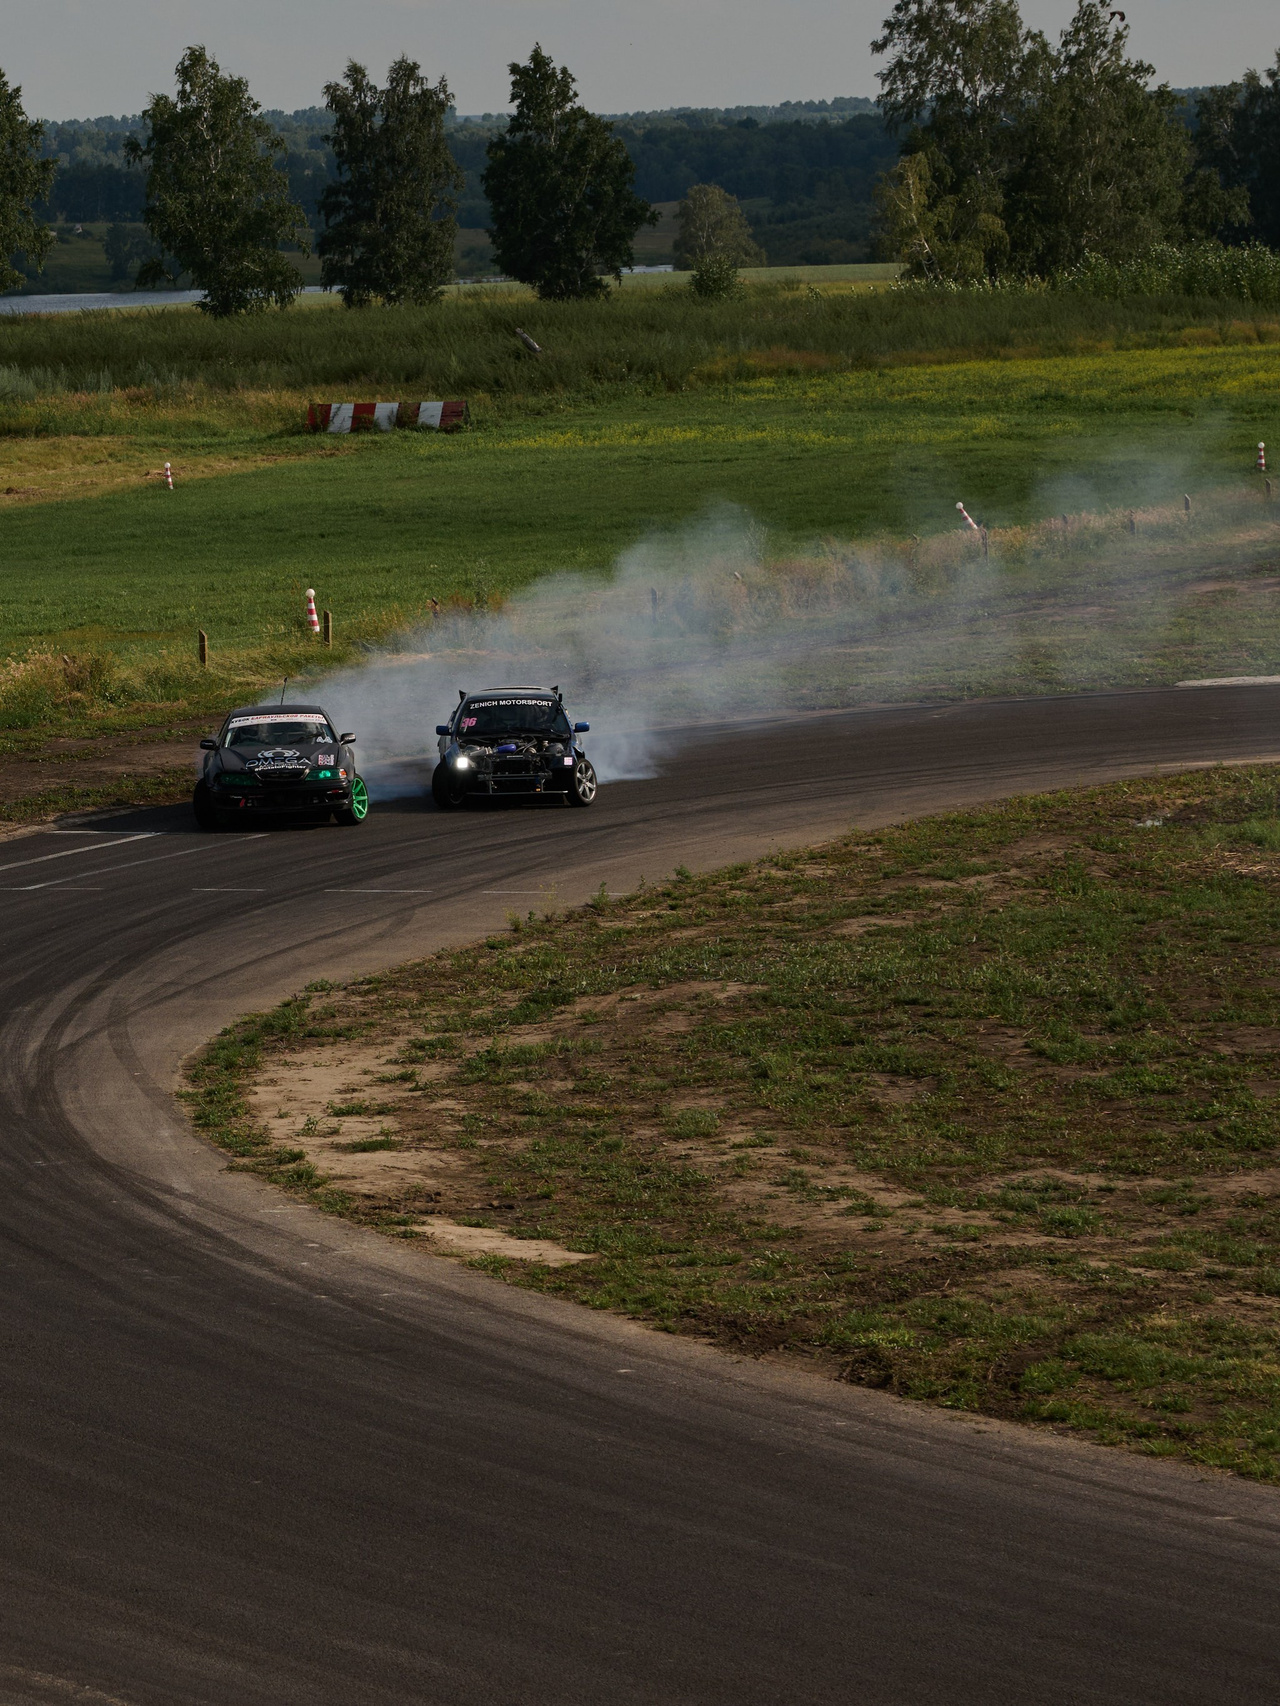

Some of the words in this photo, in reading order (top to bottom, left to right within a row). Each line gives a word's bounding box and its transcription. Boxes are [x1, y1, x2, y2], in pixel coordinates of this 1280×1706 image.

[470, 701, 497, 709] ZENICH
[461, 717, 477, 727] 36
[246, 757, 312, 767] OMEGA
